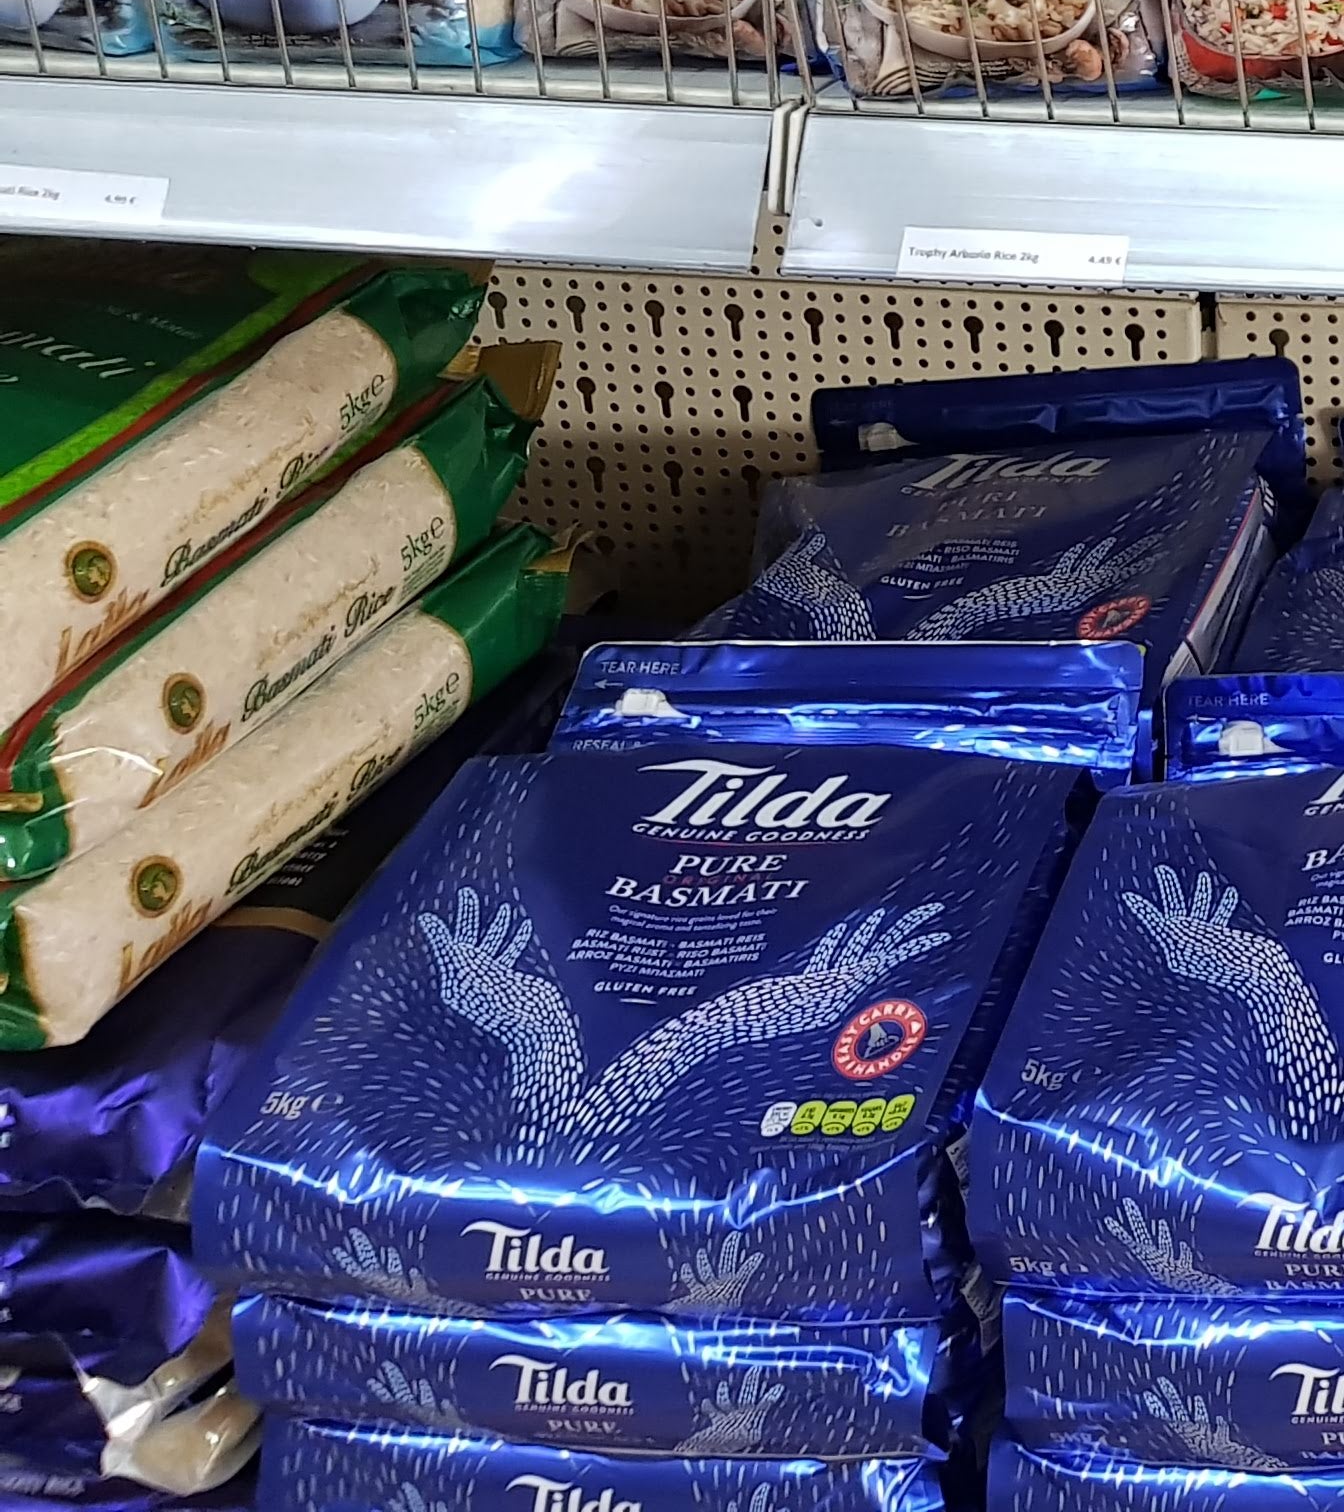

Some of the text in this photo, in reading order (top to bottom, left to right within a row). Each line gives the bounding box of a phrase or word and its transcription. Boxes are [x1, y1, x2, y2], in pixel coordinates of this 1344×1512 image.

[601, 661, 680, 675] TEAR HERE
[638, 759, 892, 828] Tilda
[632, 823, 870, 842] GENUINE GOODNESS
[672, 854, 785, 877] PURE
[606, 875, 807, 907] BASMATI
[594, 982, 698, 996] GLUTEN FREE
[1021, 1059, 1064, 1090] 5kg
[261, 1090, 306, 1117] 5kg
[461, 1220, 609, 1274] Tilda
[489, 1353, 633, 1407] Tilda
[548, 1419, 621, 1434] PURE
